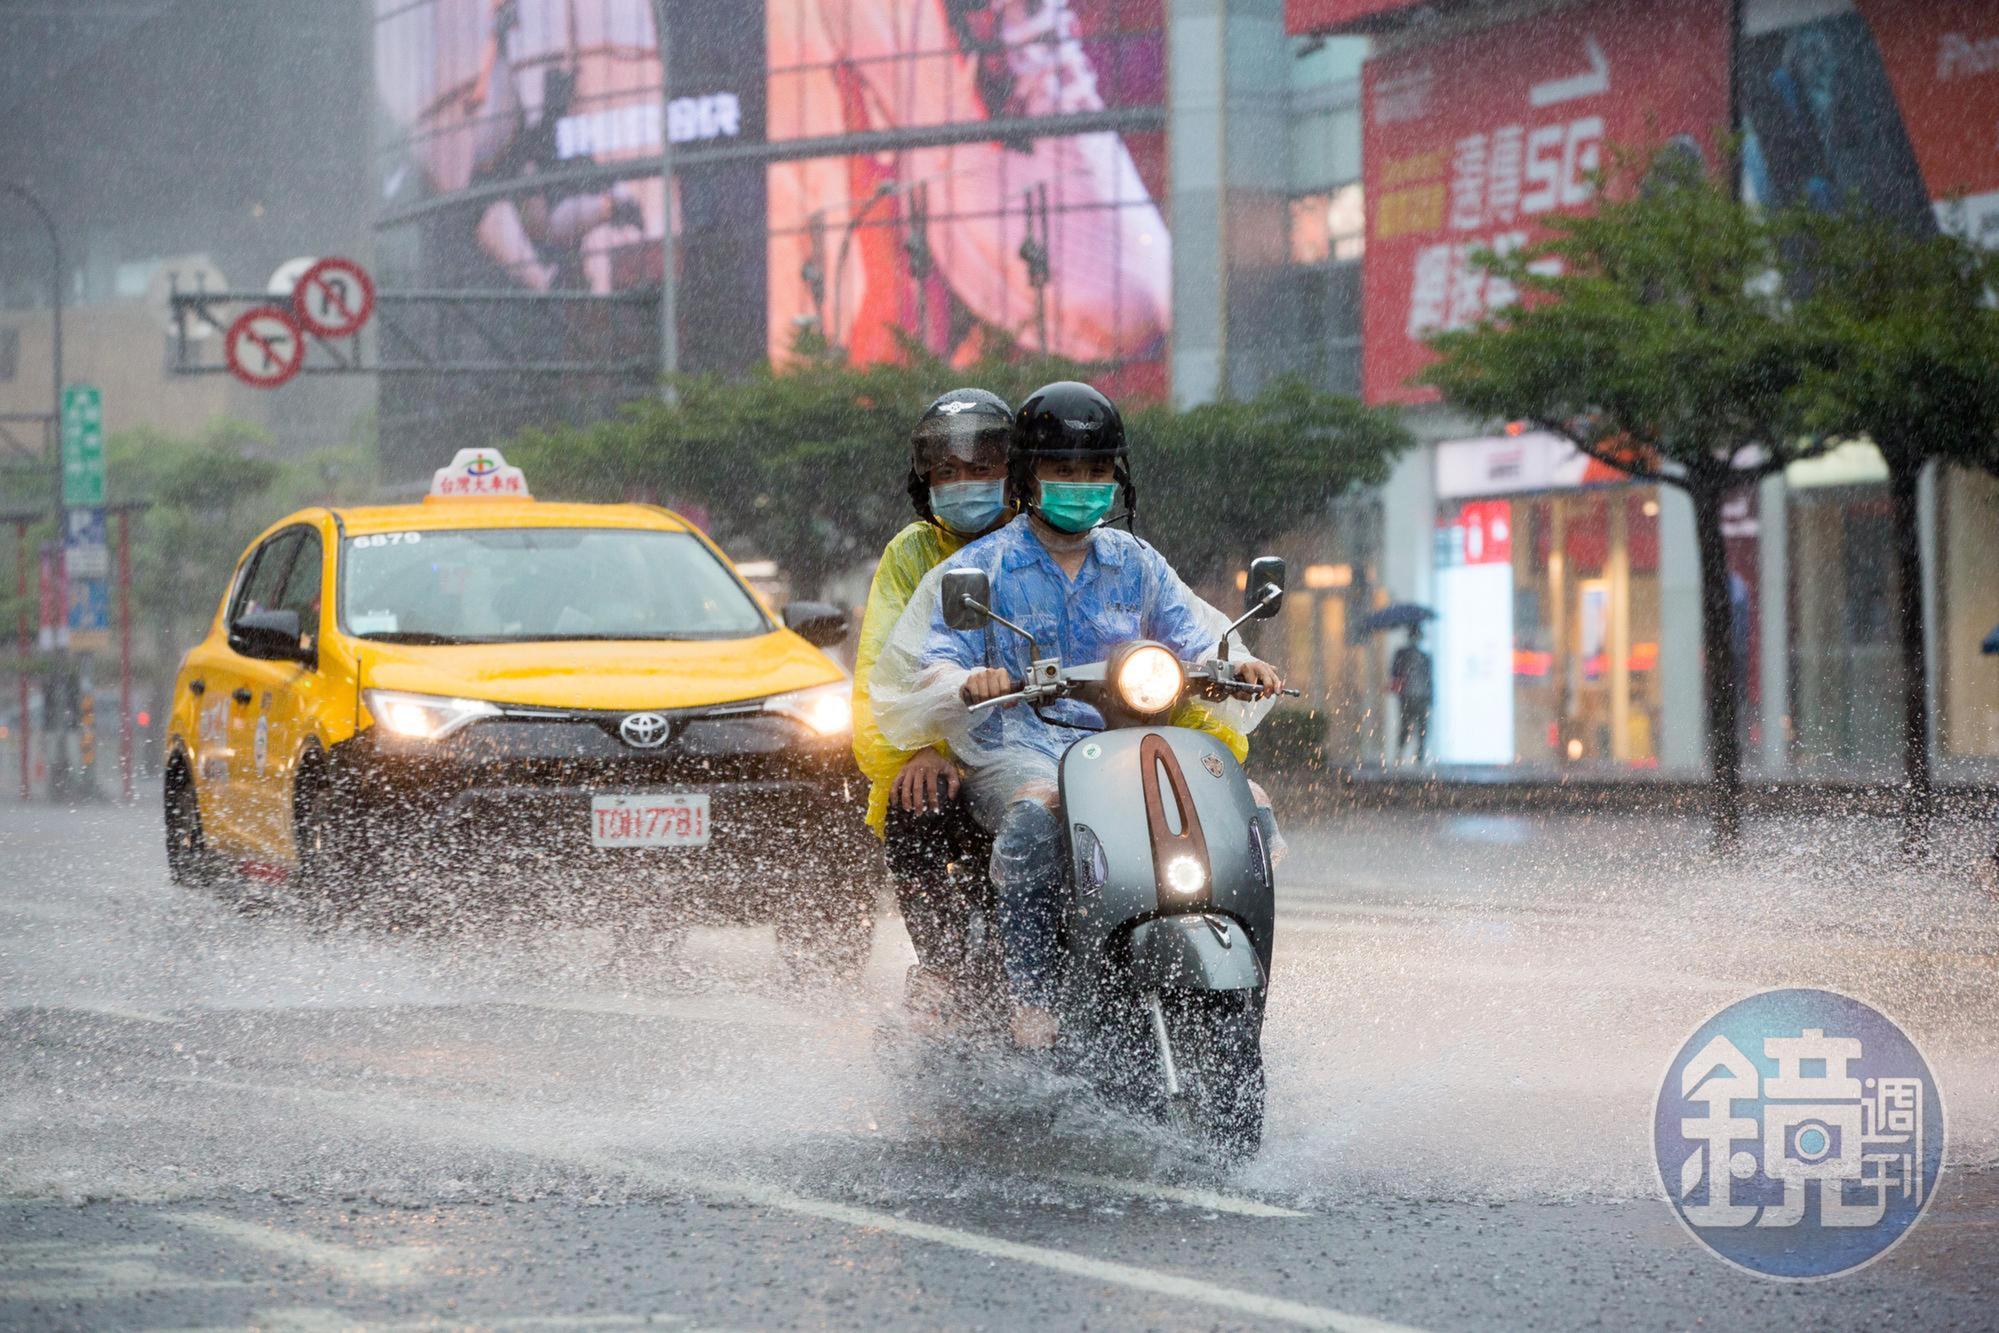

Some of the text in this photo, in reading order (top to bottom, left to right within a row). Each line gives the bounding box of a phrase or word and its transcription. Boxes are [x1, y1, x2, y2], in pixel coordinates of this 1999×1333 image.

[1520, 115, 1604, 215] 5G
[440, 475, 521, 493] 台灣大車隊
